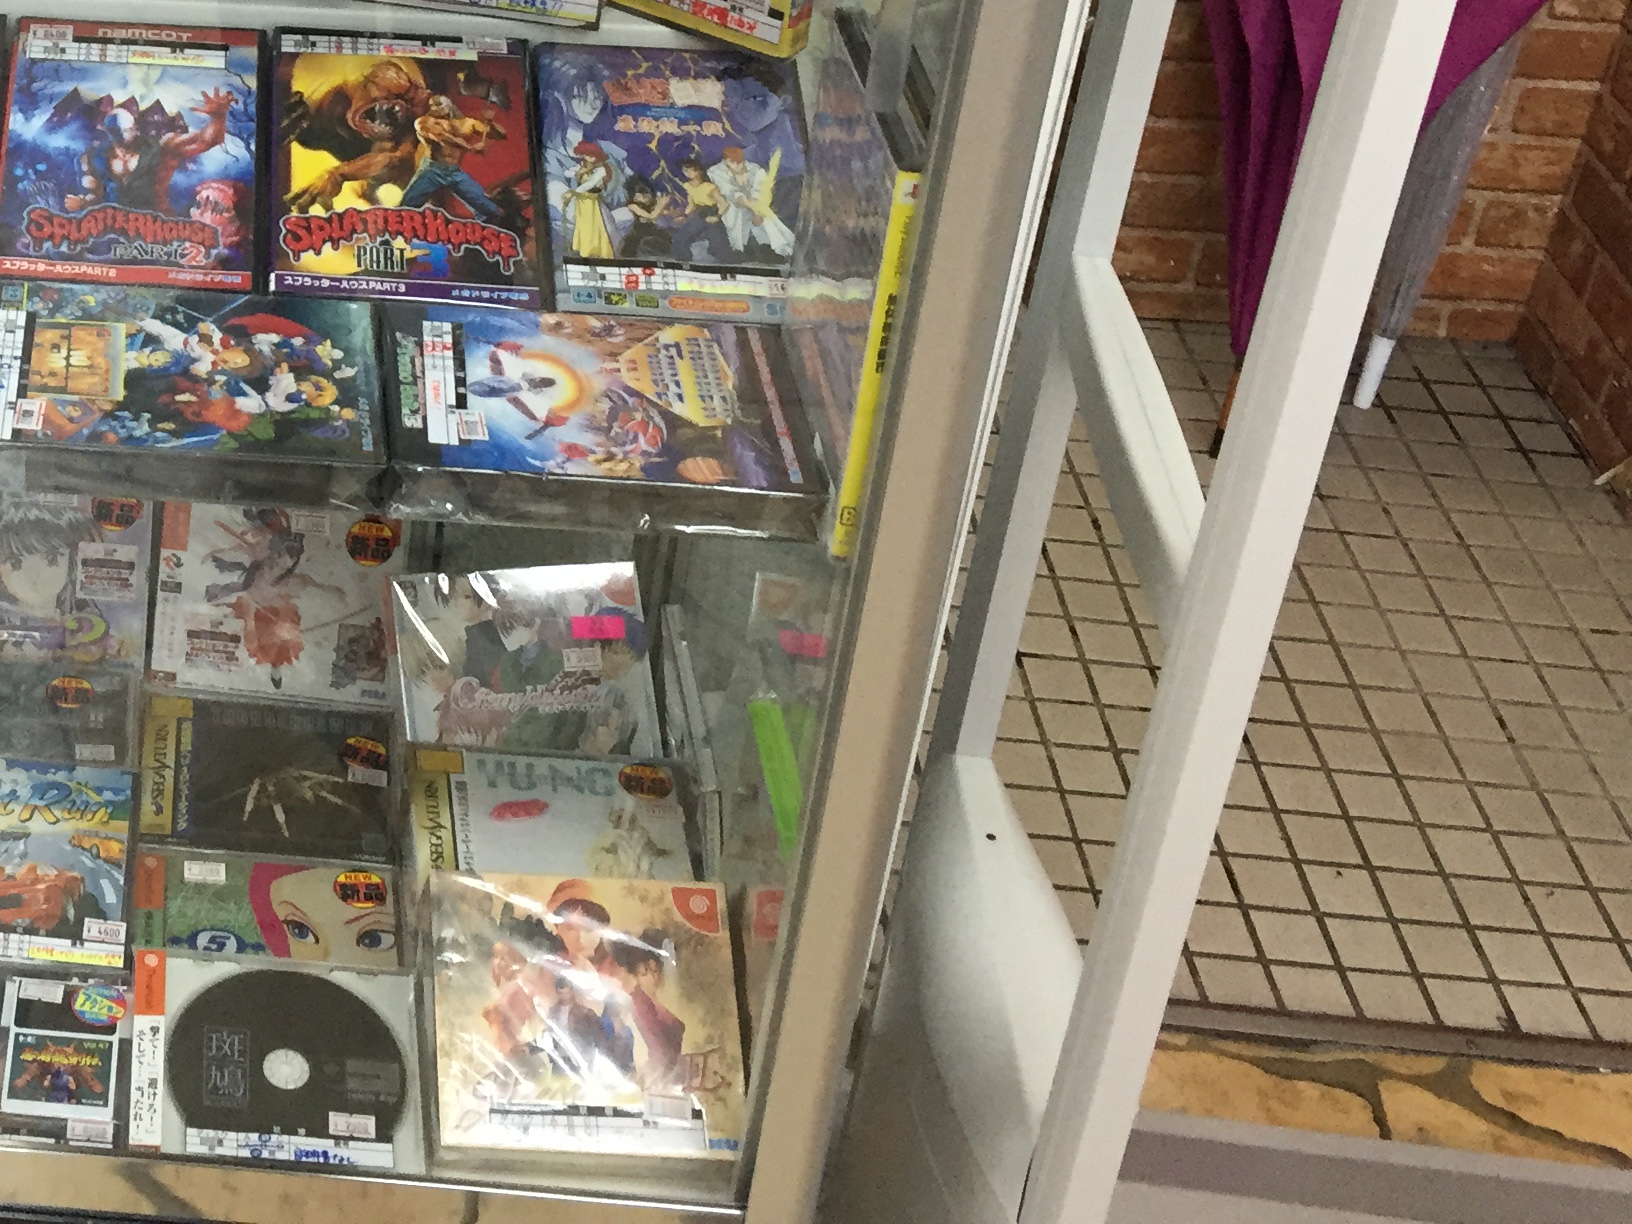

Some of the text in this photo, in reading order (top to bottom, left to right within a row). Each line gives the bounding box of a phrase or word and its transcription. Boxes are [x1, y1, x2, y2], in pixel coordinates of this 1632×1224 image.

[27, 207, 218, 251] SPLATTERHOUSE
[282, 207, 520, 272] SPLATTERHOUSE
[355, 241, 450, 277] PART 3
